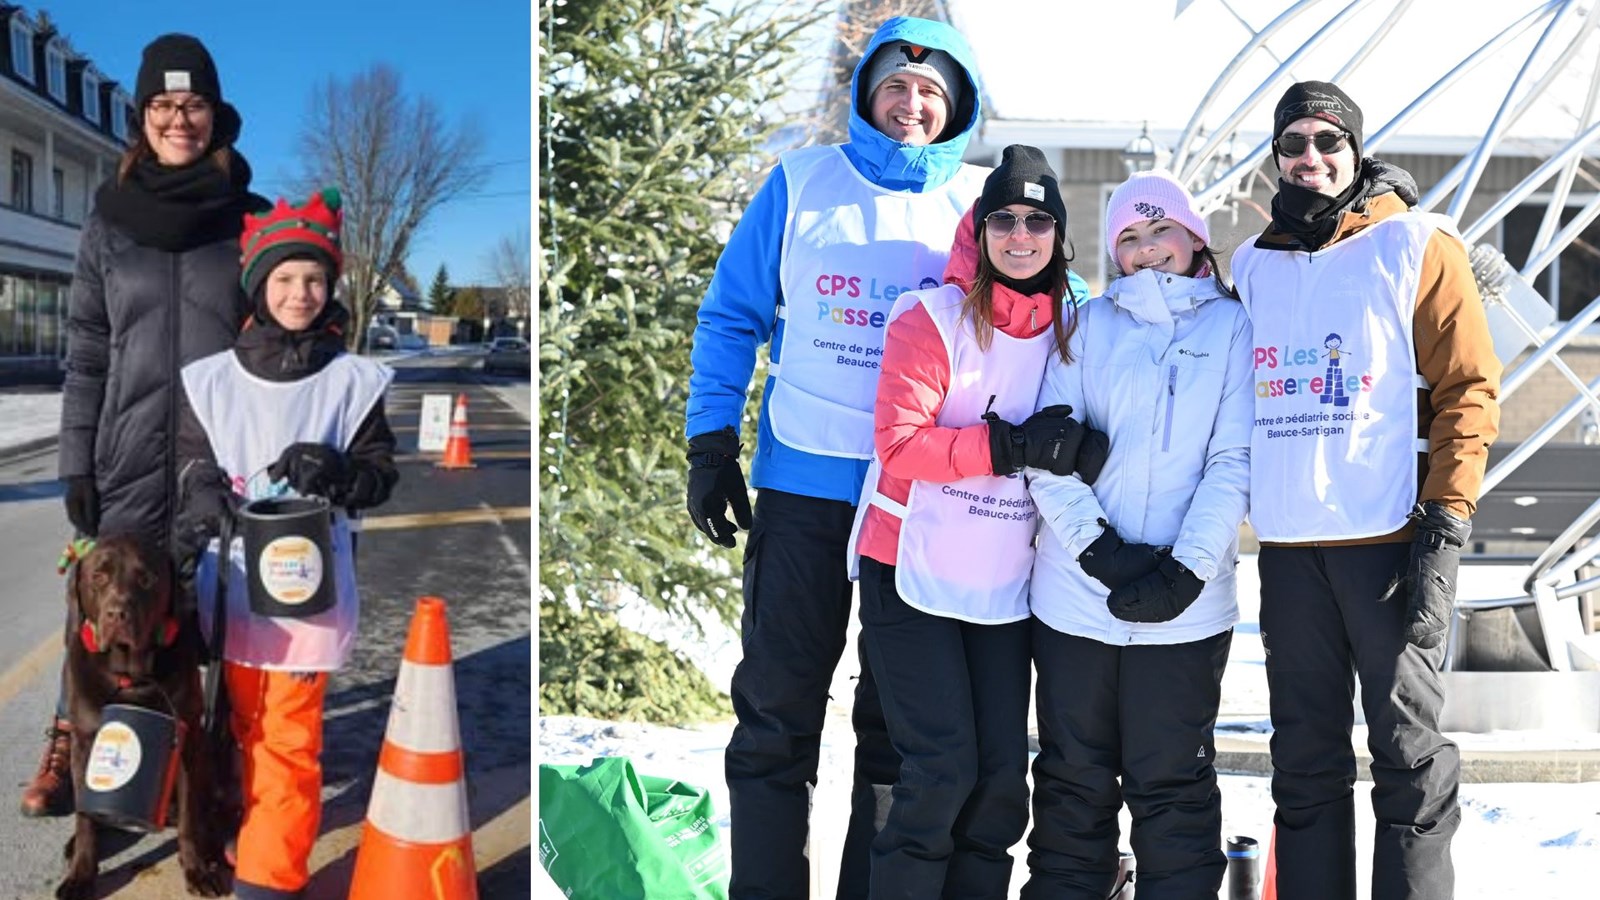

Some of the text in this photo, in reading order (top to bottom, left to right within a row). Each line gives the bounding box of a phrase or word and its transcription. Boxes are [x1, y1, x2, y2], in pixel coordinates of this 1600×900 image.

[816, 274, 862, 298] CPS
[816, 301, 890, 328] Passe
[813, 338, 846, 351] Centre
[849, 343, 863, 354] de
[1252, 345, 1319, 370] PS Les
[1254, 416, 1275, 427] ntre
[1285, 412, 1330, 424] pédiatrie
[1332, 411, 1370, 421] socie
[1267, 425, 1344, 439] Beauce-Sartigan
[941, 485, 980, 502] Centre
[982, 495, 997, 505] de
